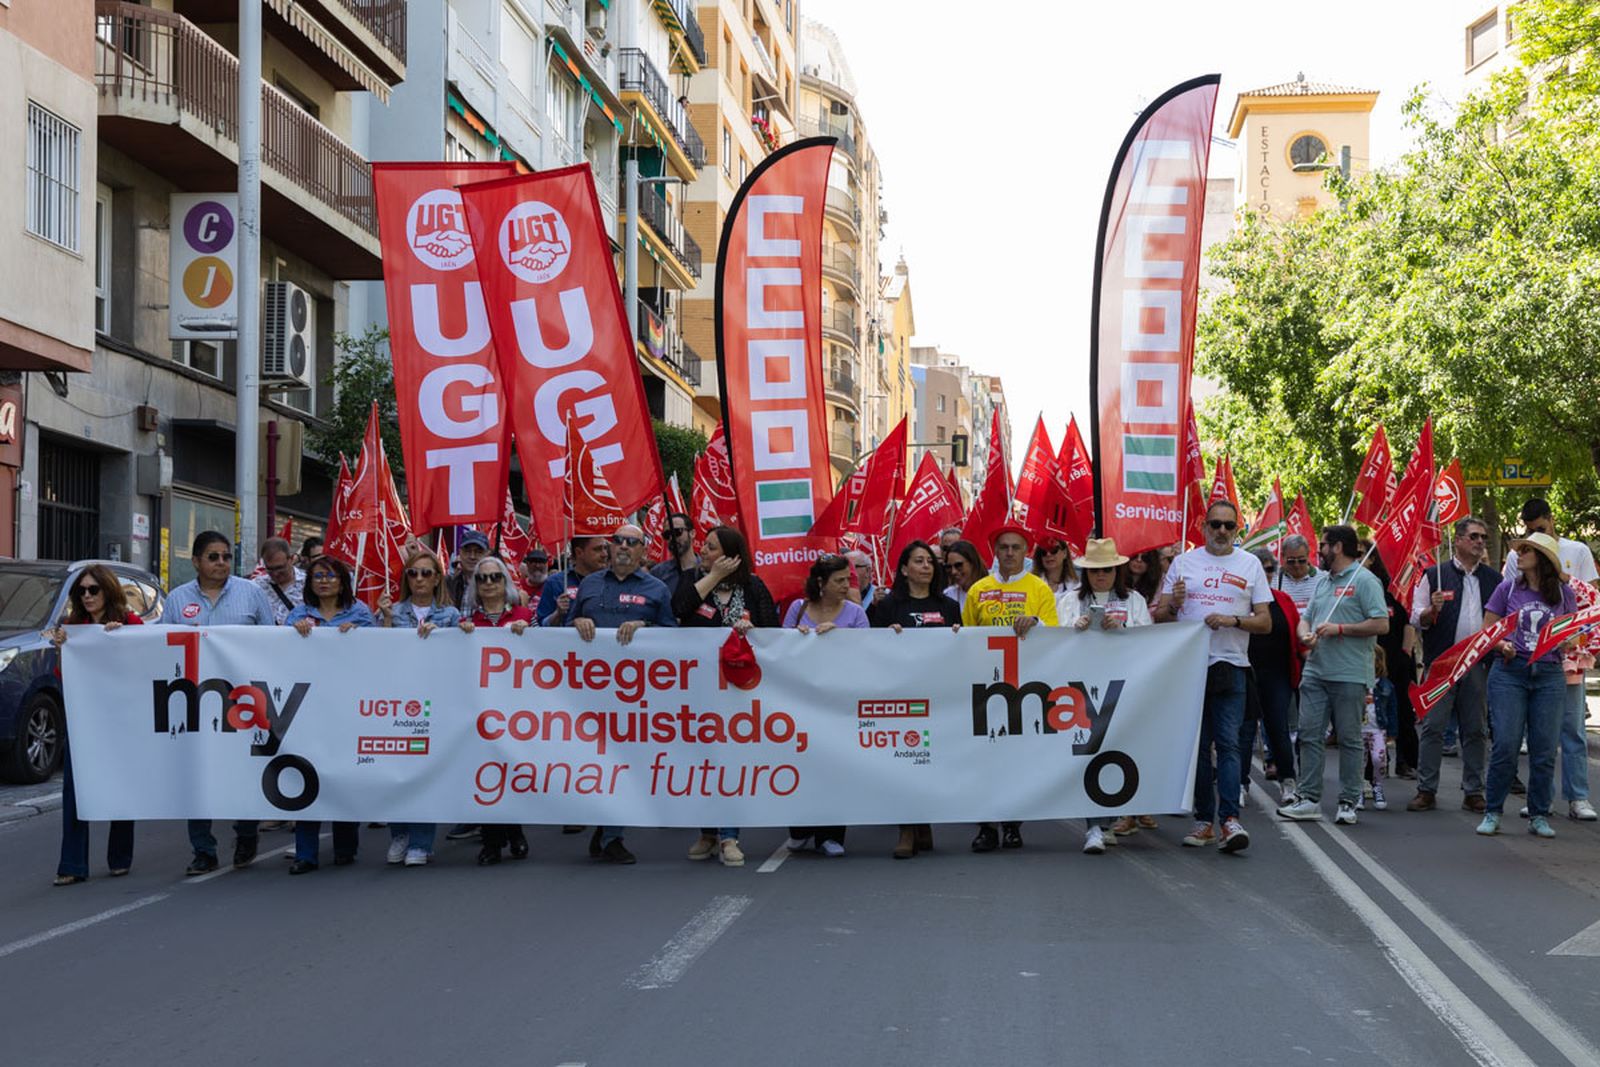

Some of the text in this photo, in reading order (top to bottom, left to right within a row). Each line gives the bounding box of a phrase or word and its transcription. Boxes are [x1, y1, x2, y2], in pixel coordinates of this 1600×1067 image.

[198, 212, 219, 243] C
[508, 213, 558, 248] UGT
[1121, 140, 1190, 424] CCOO
[747, 195, 811, 471] CCOO
[410, 281, 498, 515] UGT
[1115, 502, 1183, 524] Servicios
[167, 632, 199, 687] 1
[479, 646, 762, 703] Proteger l
[987, 636, 1019, 690] 1
[359, 699, 402, 717] UGT
[861, 703, 907, 714] CCOO
[393, 720, 430, 728] Andalucía
[476, 699, 808, 754] conquistado,
[858, 720, 875, 729] Jaén
[859, 731, 900, 748] UGT
[357, 756, 375, 765] Jaén
[361, 740, 407, 751] CCOO
[894, 750, 930, 758] Andalucía
[474, 752, 800, 806] ganar futuro
